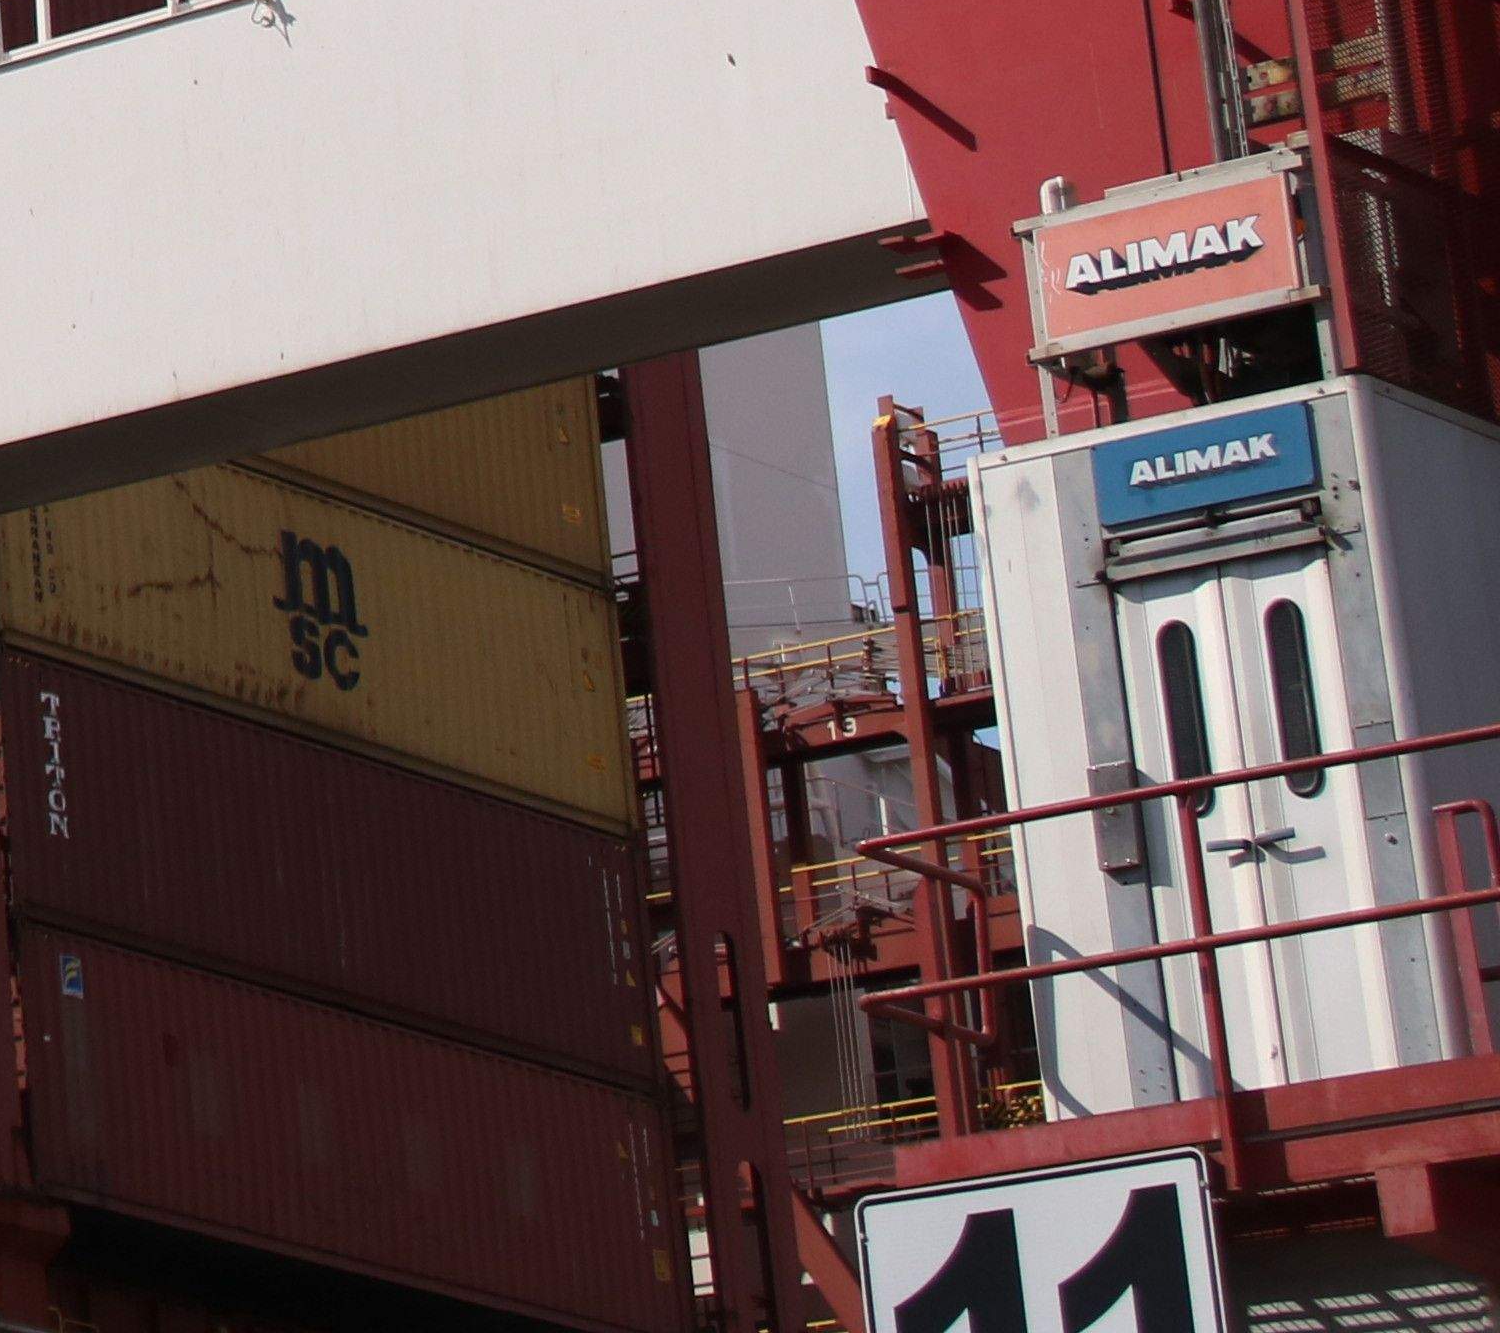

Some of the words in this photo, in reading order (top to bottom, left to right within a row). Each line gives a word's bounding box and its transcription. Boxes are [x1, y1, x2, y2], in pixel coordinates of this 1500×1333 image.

[1065, 214, 1264, 292] ALIMAK
[1127, 431, 1279, 488] ALIMAK
[39, 690, 71, 841] TRITON
[827, 716, 858, 741] 13
[893, 1182, 1201, 1333] 11
